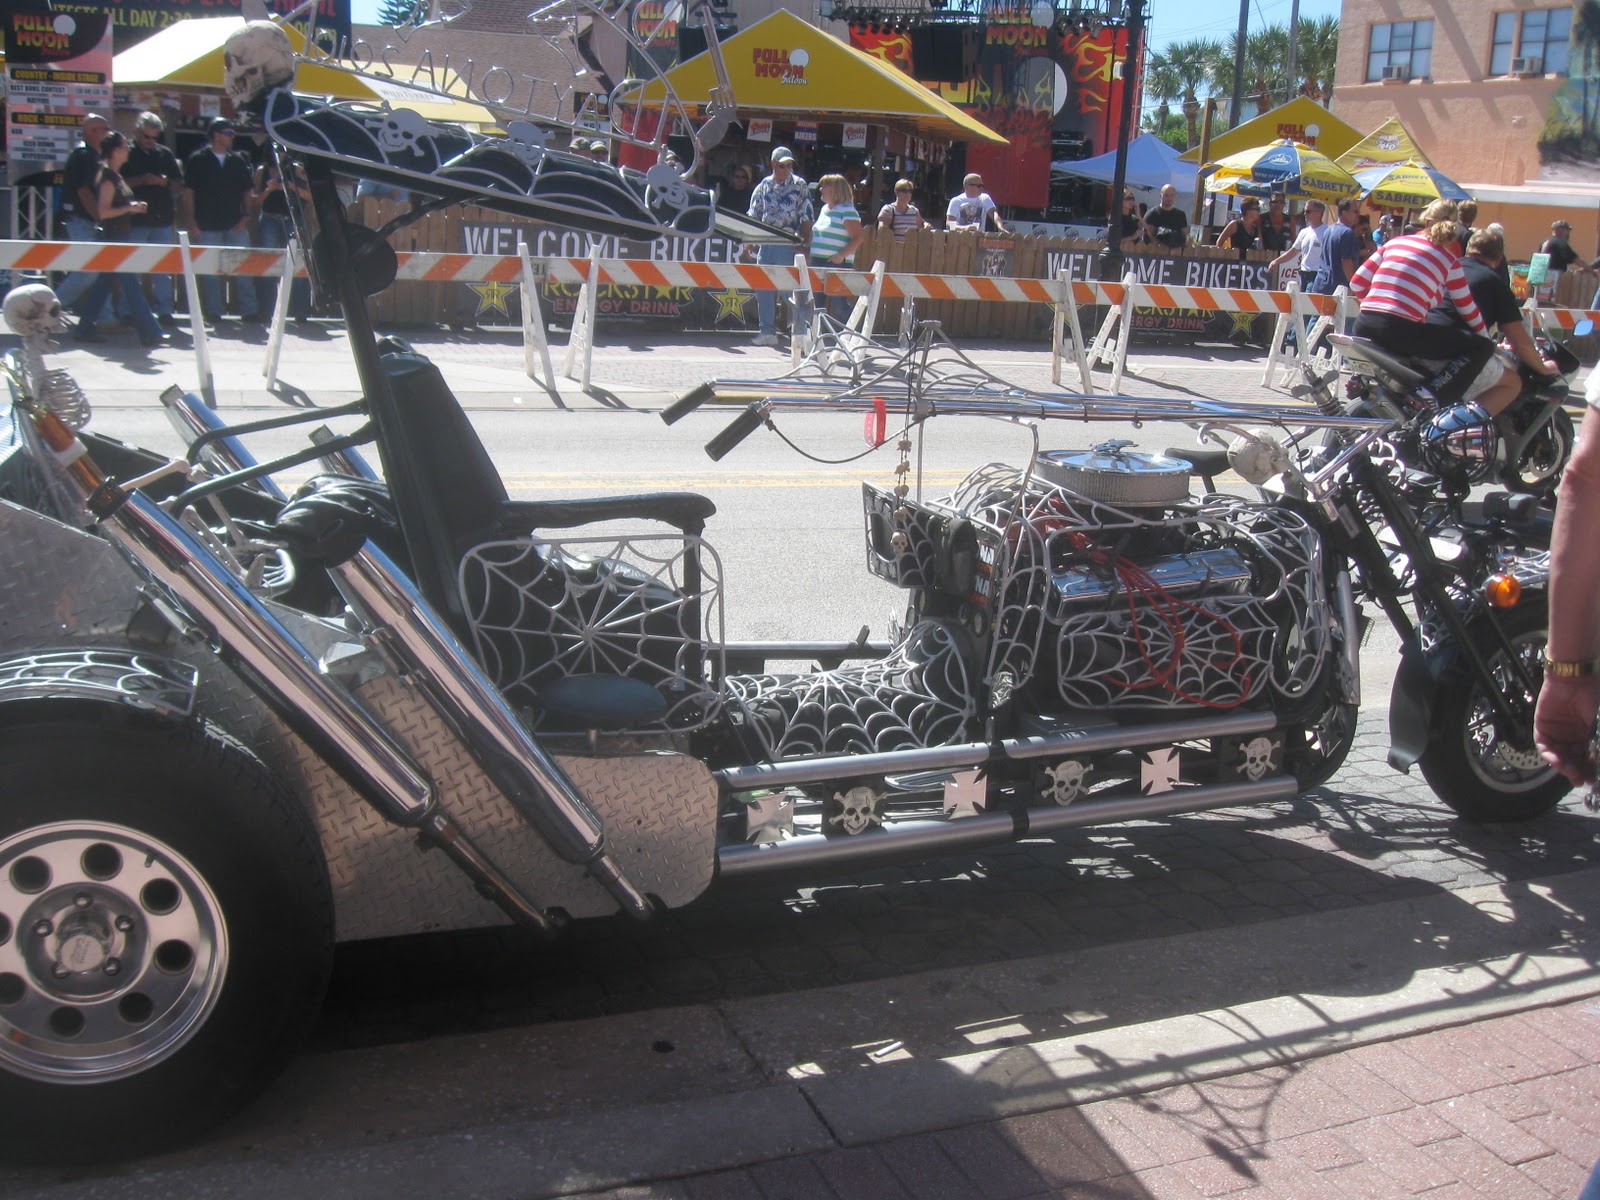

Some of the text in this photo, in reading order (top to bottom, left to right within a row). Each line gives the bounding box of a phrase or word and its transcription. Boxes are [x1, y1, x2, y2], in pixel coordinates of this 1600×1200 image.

[13, 14, 54, 32] FULL
[130, 10, 157, 27] DAY
[17, 32, 70, 48] MOON
[985, 25, 1047, 46] MOON
[753, 48, 789, 64] FULL
[755, 62, 804, 78] MOON
[781, 72, 808, 85] Saloon
[794, 130, 818, 141] BIKERS
[1276, 123, 1304, 135] FULL
[1302, 176, 1353, 193] SABRETT
[1376, 191, 1433, 205] SABRET
[1048, 252, 1269, 290] WELOME BIKERS
[1281, 268, 1298, 279] ICE
[555, 297, 679, 314] ENGY DRINK
[1167, 318, 1205, 331] DRINK
